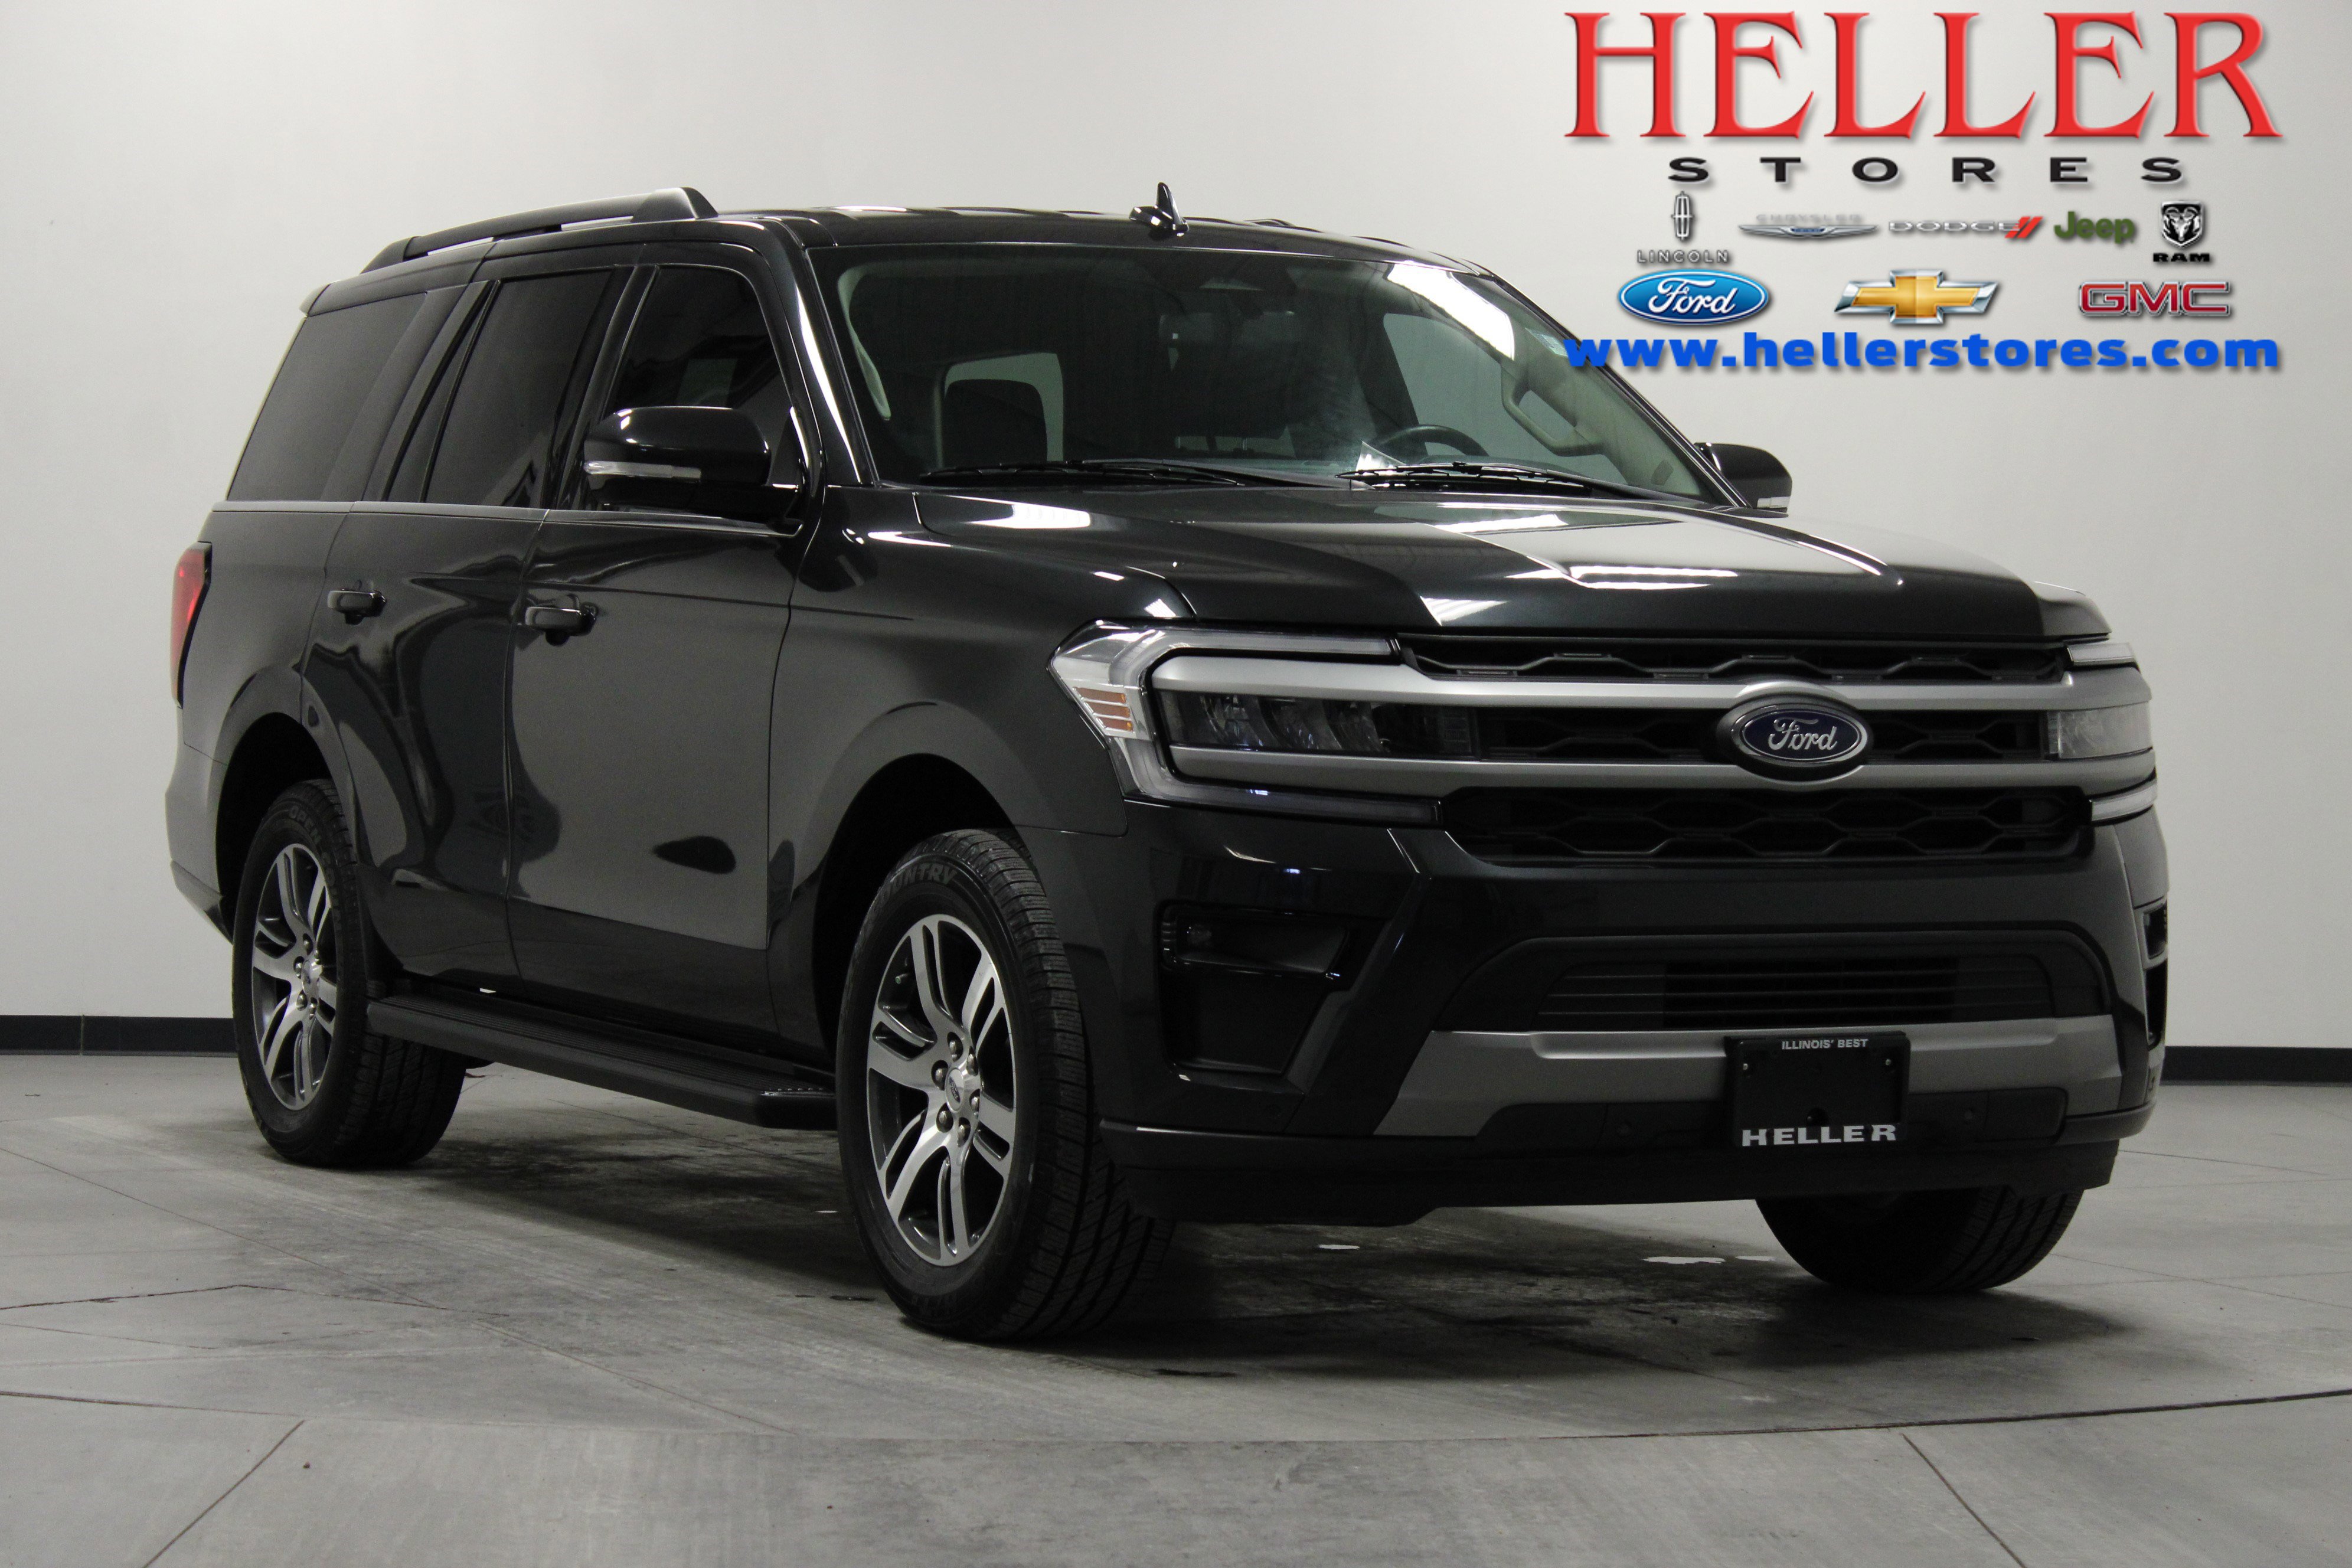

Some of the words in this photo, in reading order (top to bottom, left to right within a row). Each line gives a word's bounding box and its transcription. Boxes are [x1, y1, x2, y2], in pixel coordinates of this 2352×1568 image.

[1768, 717, 1837, 750] Ford
[1837, 1038, 1868, 1048] BEST
[1742, 1125, 1896, 1146] HELLER
